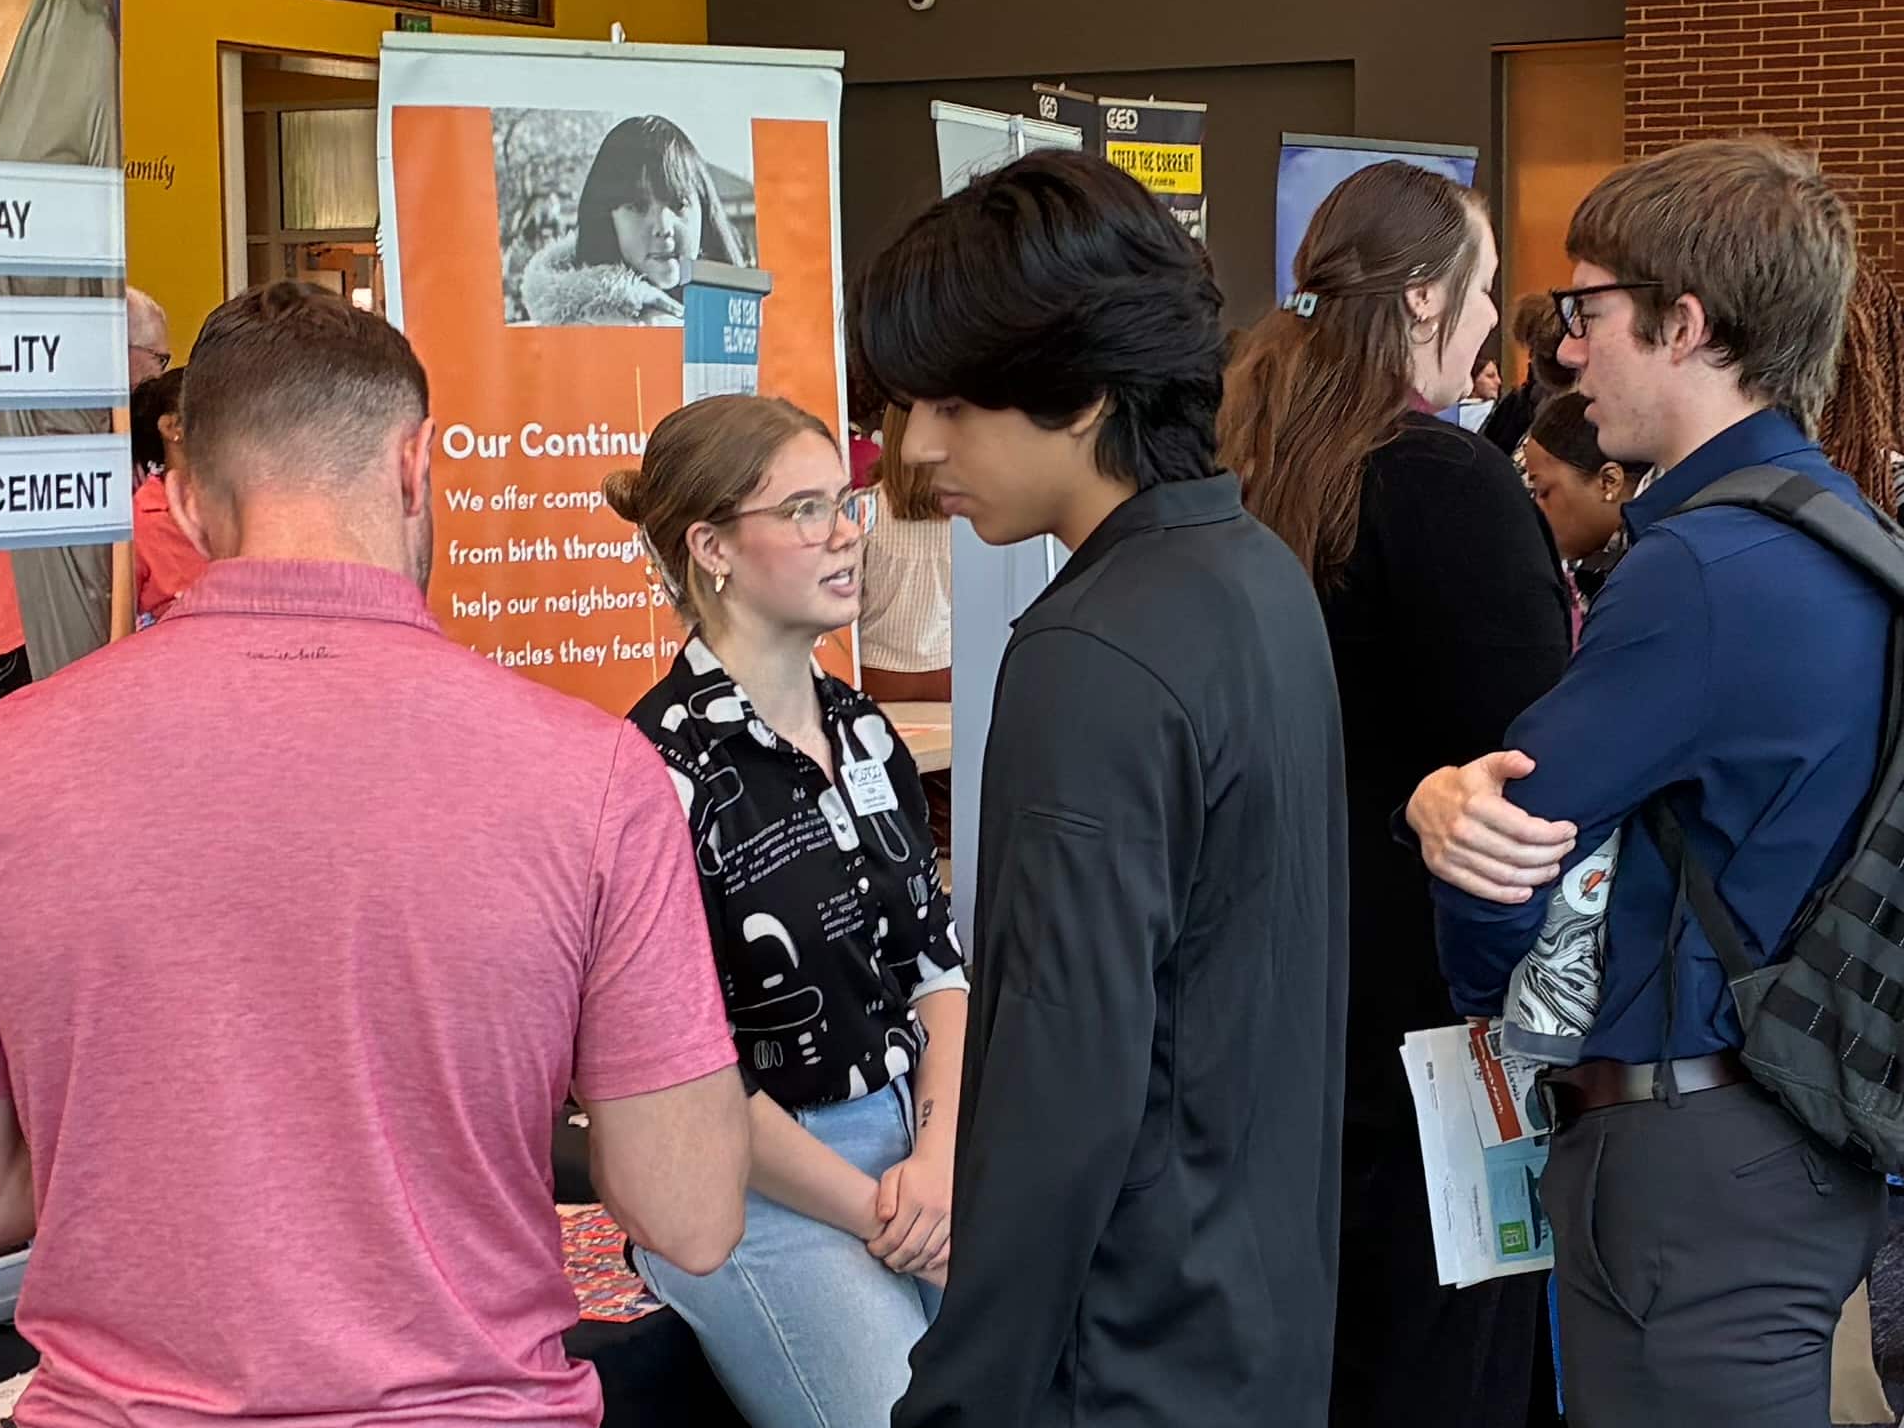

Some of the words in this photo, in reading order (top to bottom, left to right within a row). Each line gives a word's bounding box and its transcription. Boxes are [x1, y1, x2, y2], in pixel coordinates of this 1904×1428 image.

[124, 155, 175, 190] amily
[442, 423, 512, 460] Our
[445, 486, 484, 512] We
[490, 484, 538, 511] offer
[543, 490, 607, 514] comp
[449, 538, 503, 565] from
[507, 536, 558, 563] birth
[563, 532, 645, 564] through
[452, 591, 502, 622] help
[507, 597, 539, 614] our
[545, 585, 647, 617] neighbors
[559, 637, 608, 668] they
[613, 635, 655, 660] face
